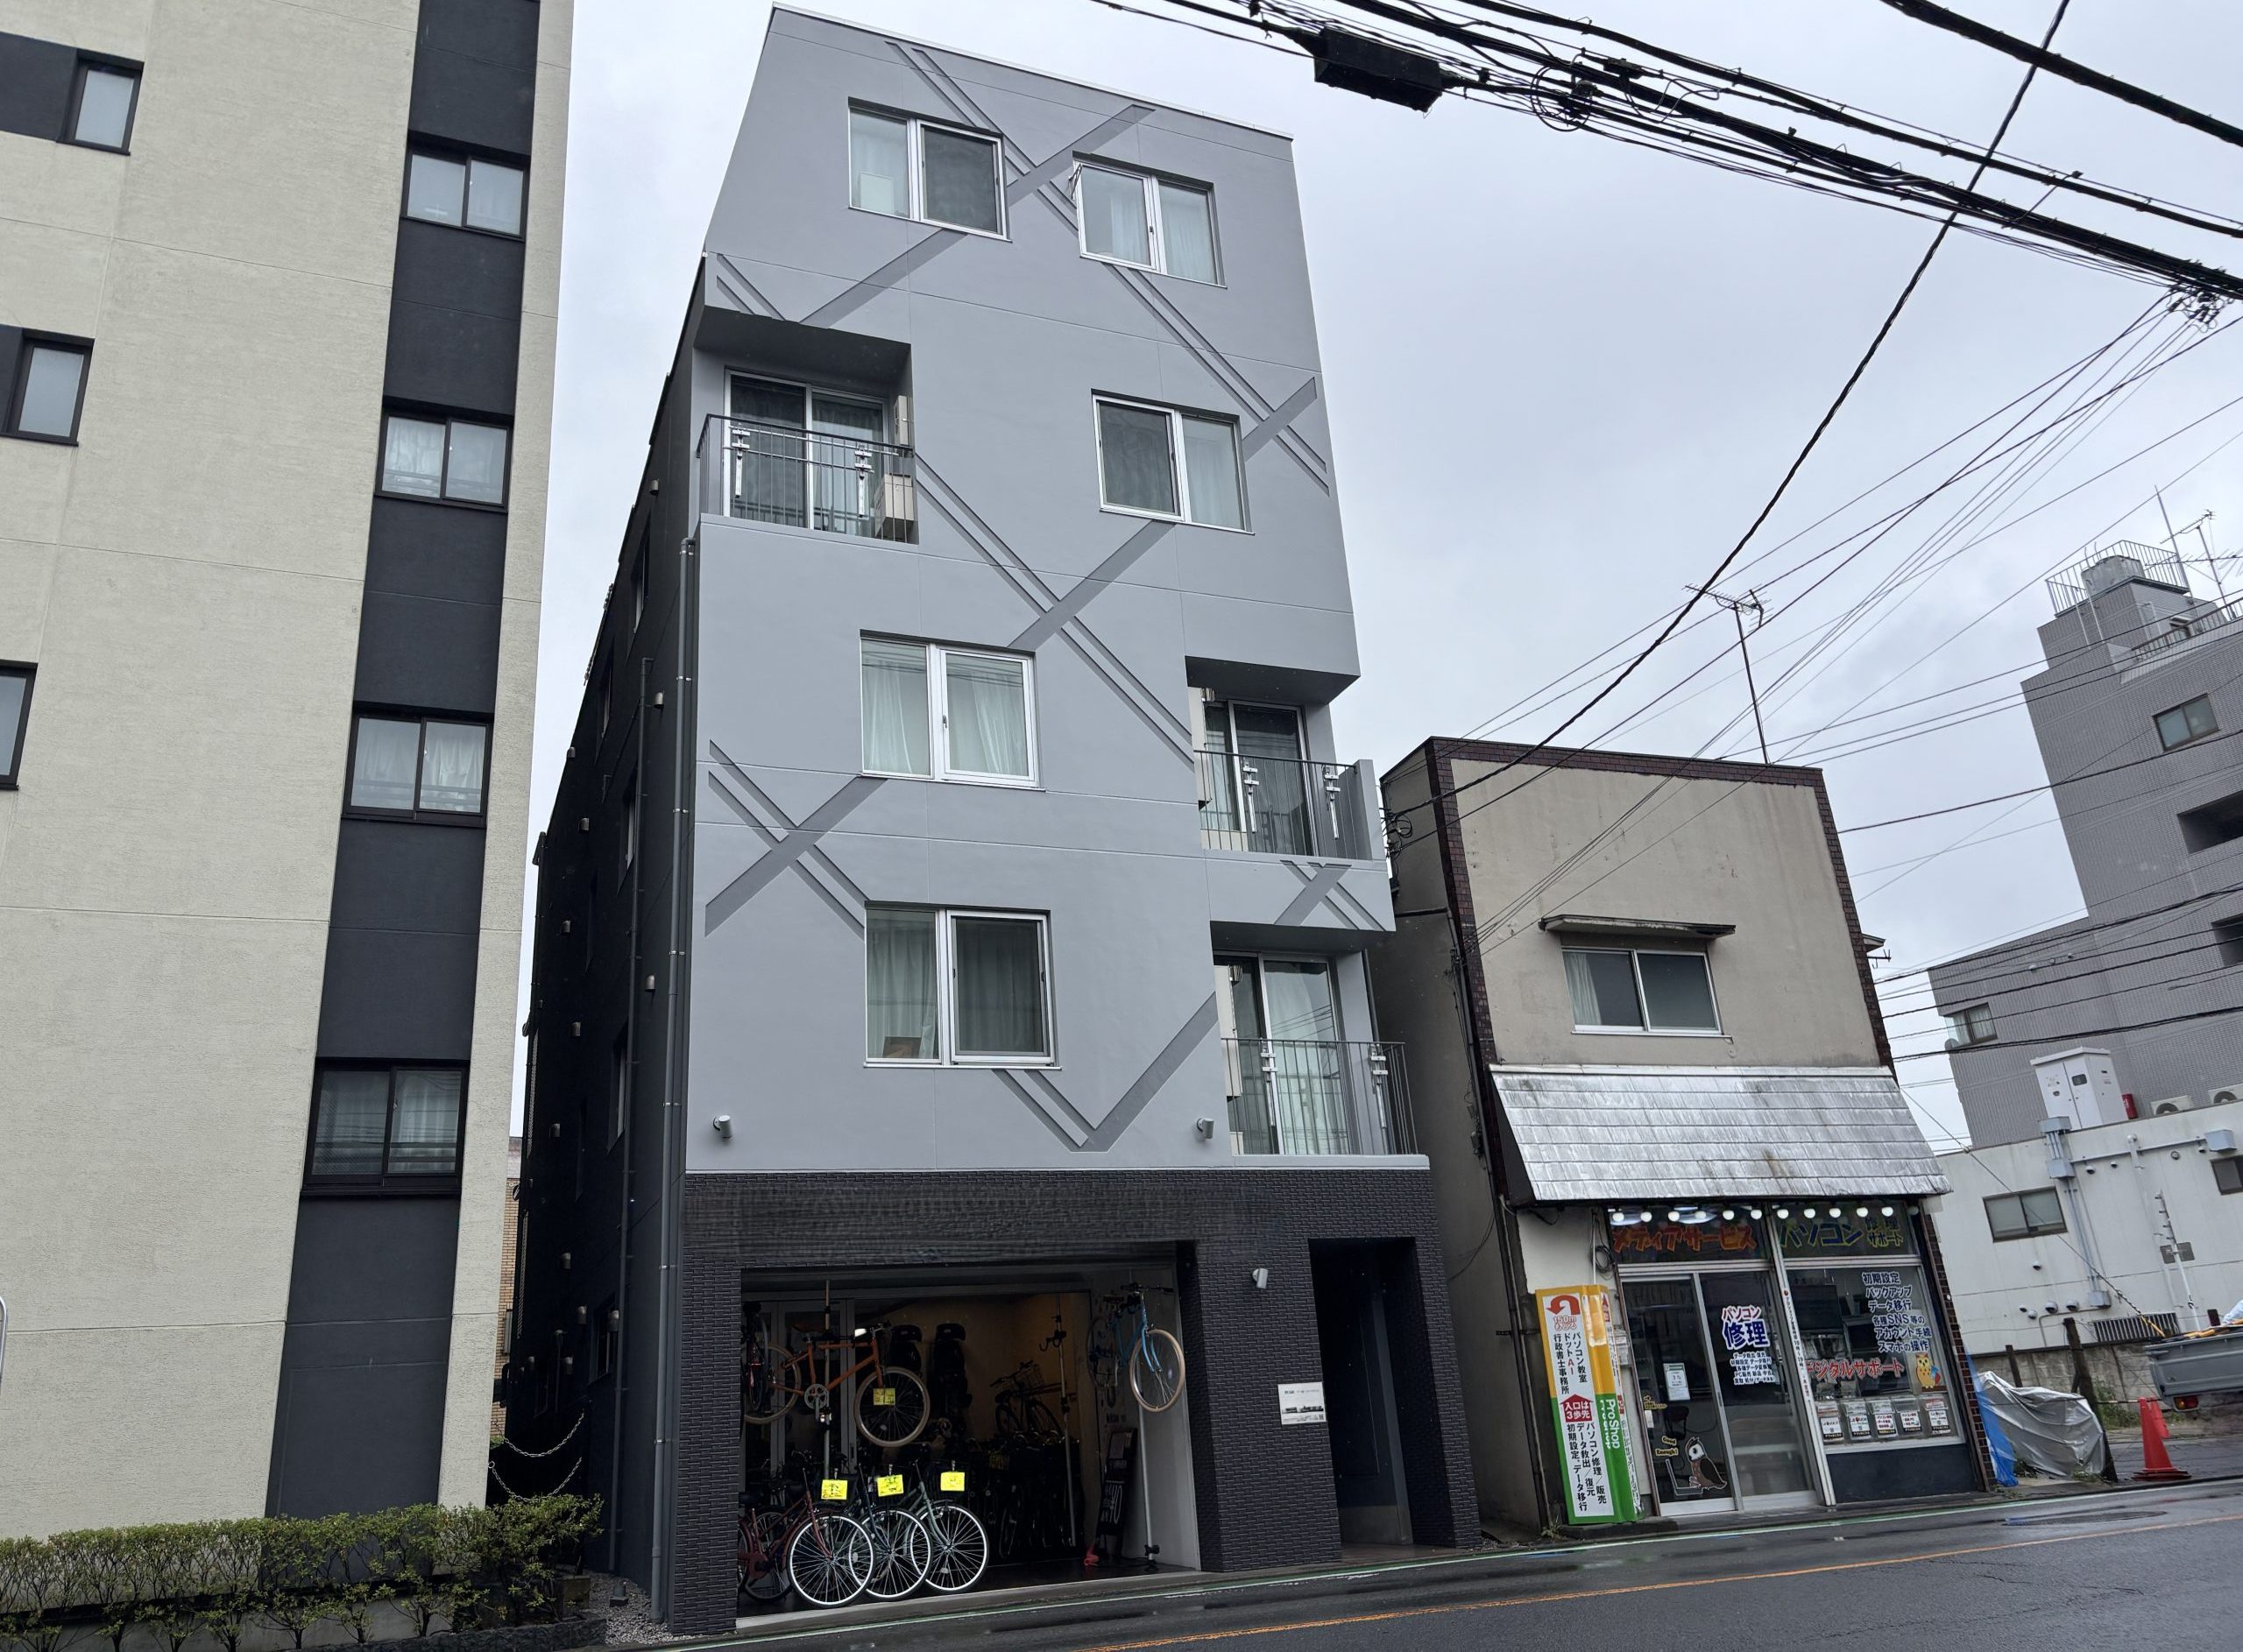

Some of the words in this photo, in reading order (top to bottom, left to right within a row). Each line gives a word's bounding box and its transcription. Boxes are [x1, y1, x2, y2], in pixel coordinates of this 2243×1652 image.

[1862, 1271, 1900, 1286] 初期設定
[1722, 1305, 1761, 1321] パソコン
[1868, 1298, 1913, 1313] データ移行
[1723, 1319, 1770, 1350] 修理
[1553, 1333, 1570, 1394] 行政書士事務所
[1573, 1332, 1588, 1383] パソコン教室
[1565, 1401, 1589, 1410] 入口は
[1605, 1399, 1621, 1450] ProShop
